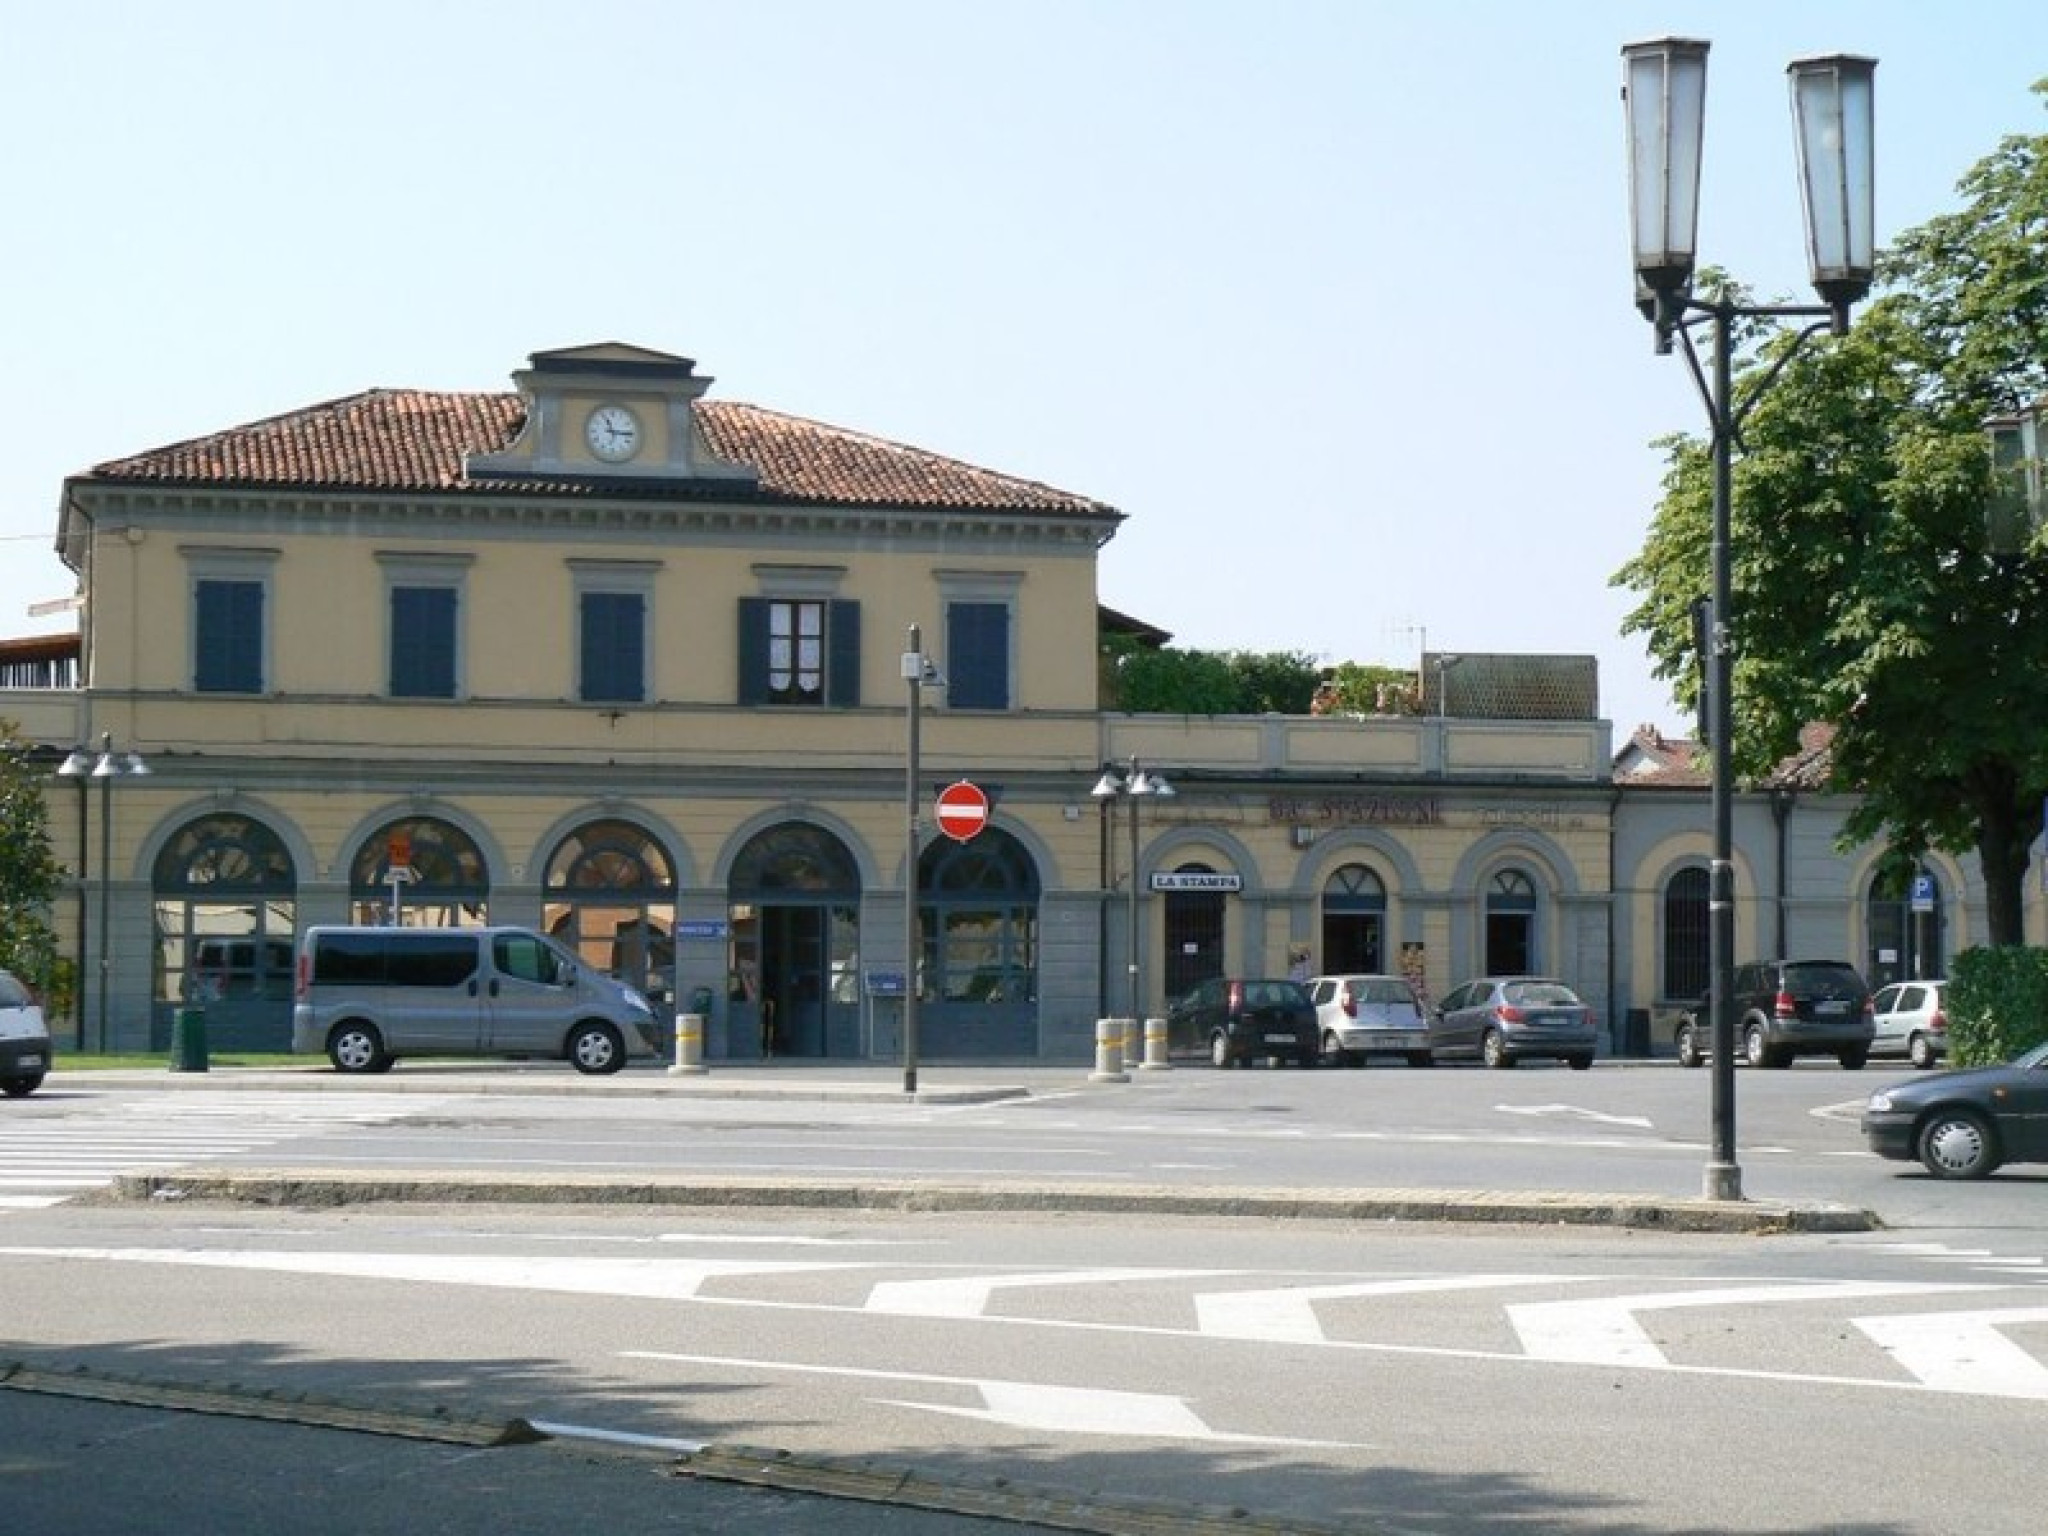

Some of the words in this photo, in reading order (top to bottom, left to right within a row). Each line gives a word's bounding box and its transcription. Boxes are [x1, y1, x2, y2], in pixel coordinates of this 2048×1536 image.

[1156, 877, 1176, 887] LA
[1180, 877, 1237, 887] STAMPA
[1914, 877, 1929, 897] P
